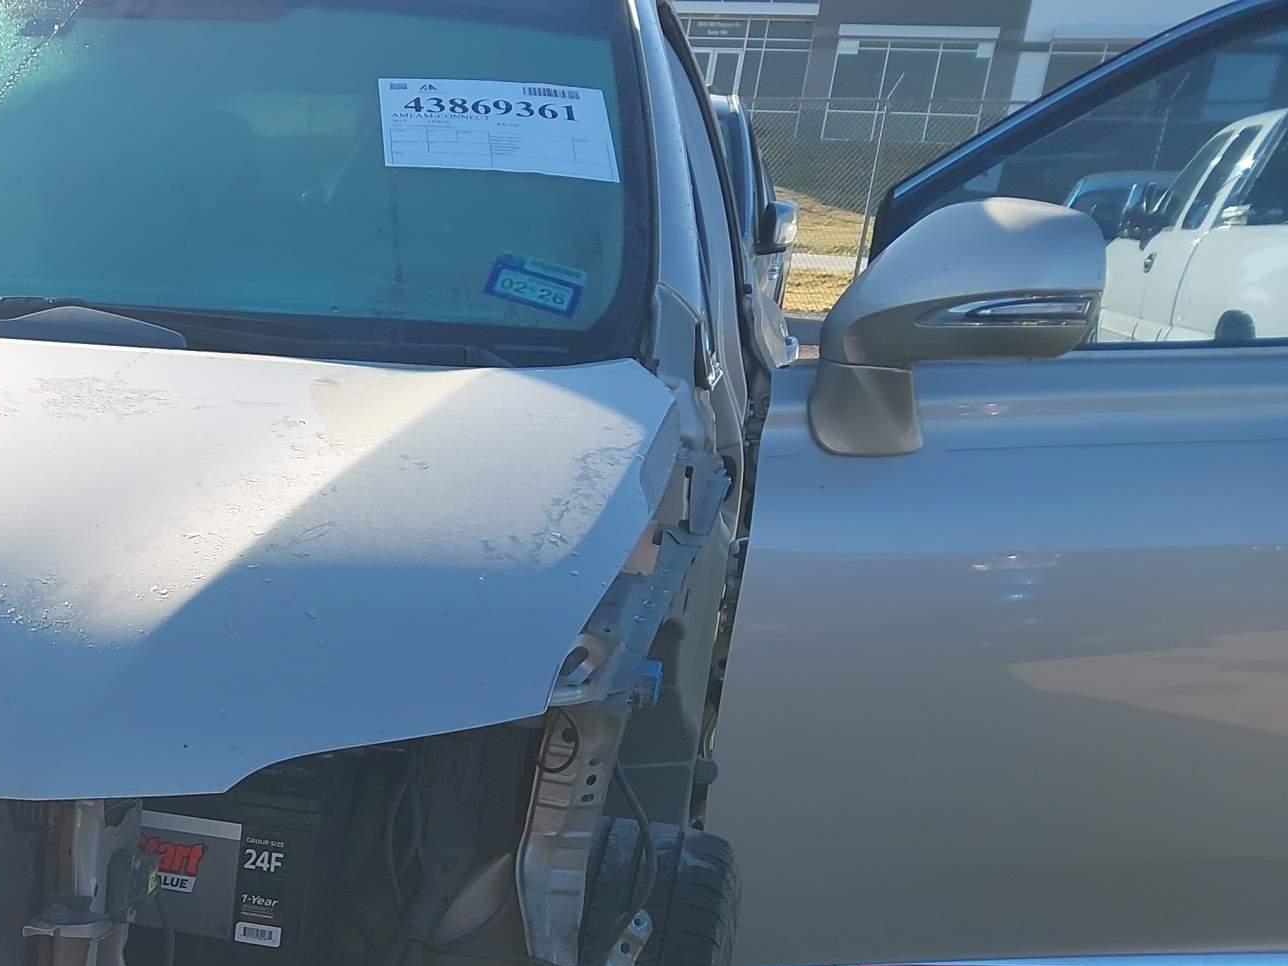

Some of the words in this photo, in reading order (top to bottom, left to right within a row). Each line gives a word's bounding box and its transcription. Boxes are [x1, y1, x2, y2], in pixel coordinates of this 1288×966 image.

[403, 96, 579, 121] 43869361
[246, 837, 270, 846] GROUP
[270, 840, 285, 848] SIZE
[243, 848, 285, 873] 24F
[241, 894, 279, 907] 1-Year
